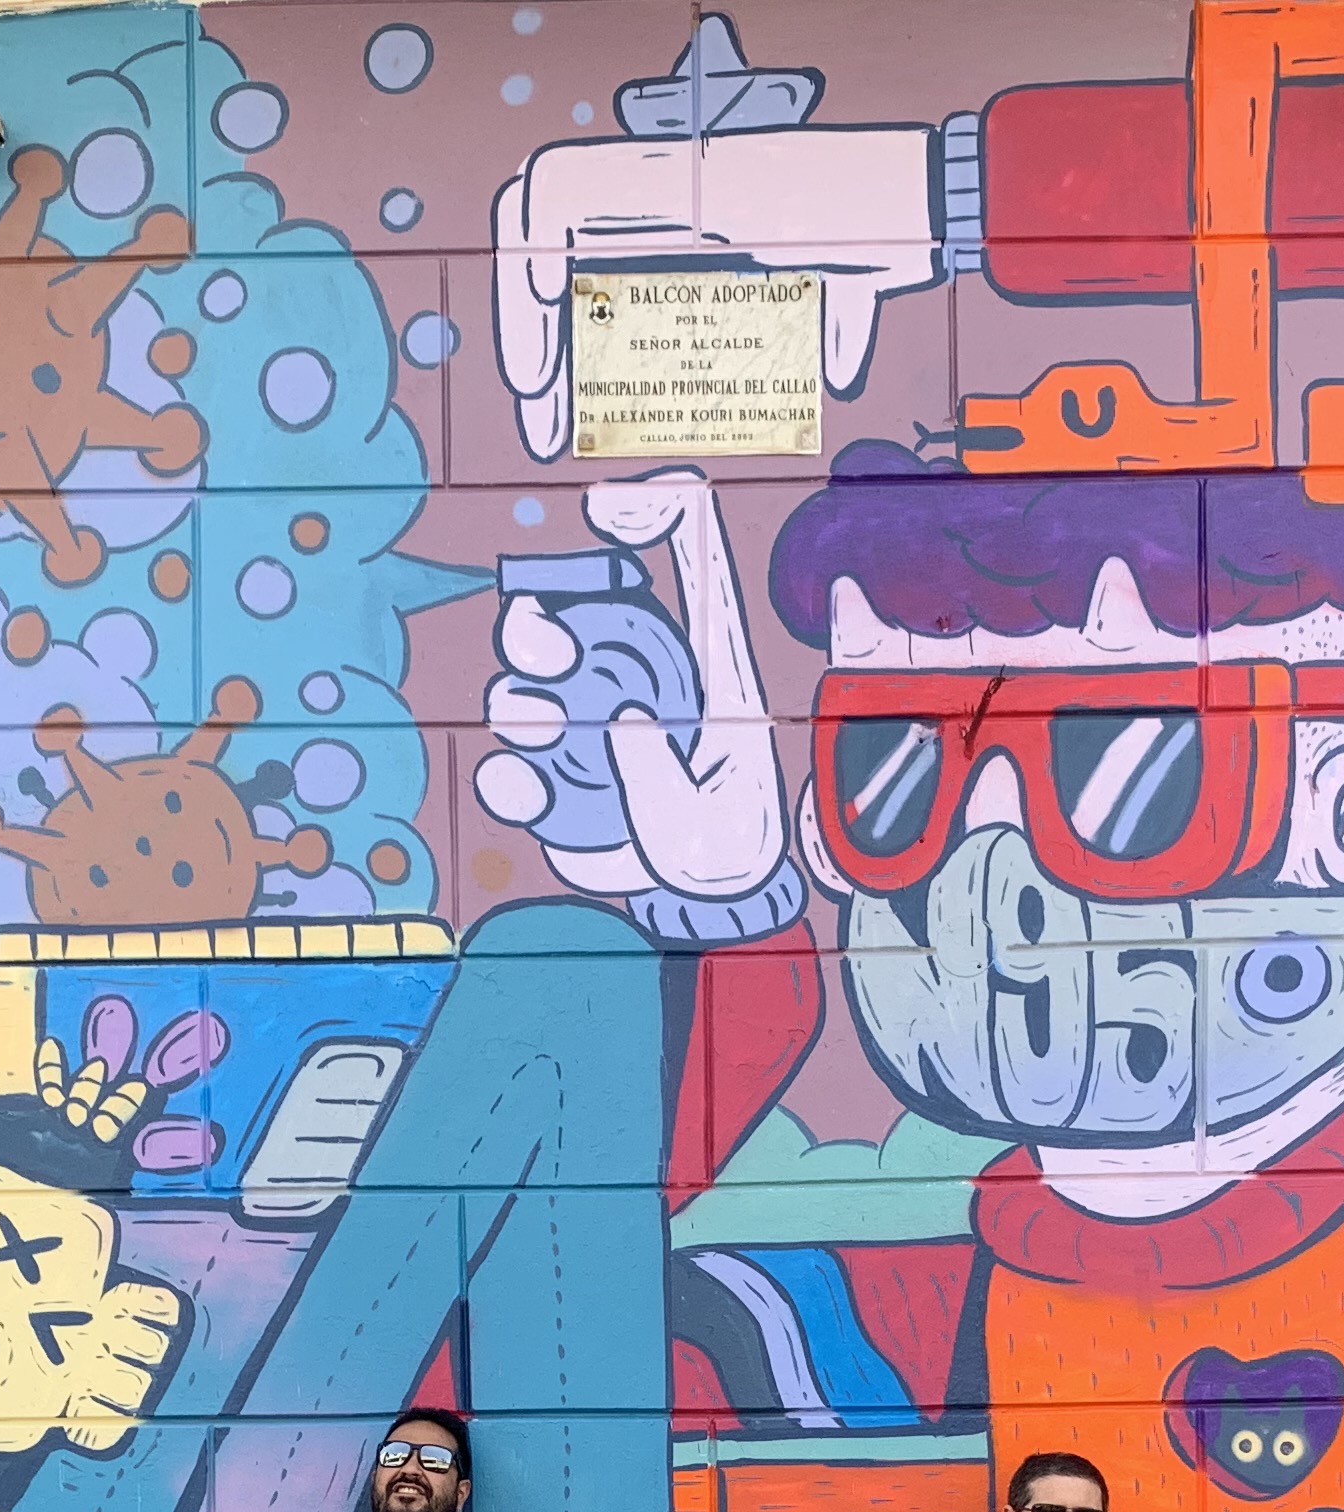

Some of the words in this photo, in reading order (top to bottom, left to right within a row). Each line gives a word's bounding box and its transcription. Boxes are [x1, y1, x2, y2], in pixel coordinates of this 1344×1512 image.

[630, 285, 702, 305] BALCON
[711, 284, 803, 303] ADOPTADO
[675, 315, 698, 326] POR
[629, 335, 681, 350] SEÑOR
[690, 338, 765, 350] ALCALDE
[680, 360, 694, 370] DE
[698, 360, 713, 370] LA
[578, 380, 666, 396] MUNICIPALIDAD
[671, 379, 740, 396] PROVINCIAL
[744, 379, 768, 395] DEL
[772, 378, 816, 394] CALLAO
[602, 410, 684, 423] ALEXANDER
[690, 409, 733, 421] KOURI
[738, 407, 816, 421] BUMACHAR
[679, 434, 707, 443] JUNIO
